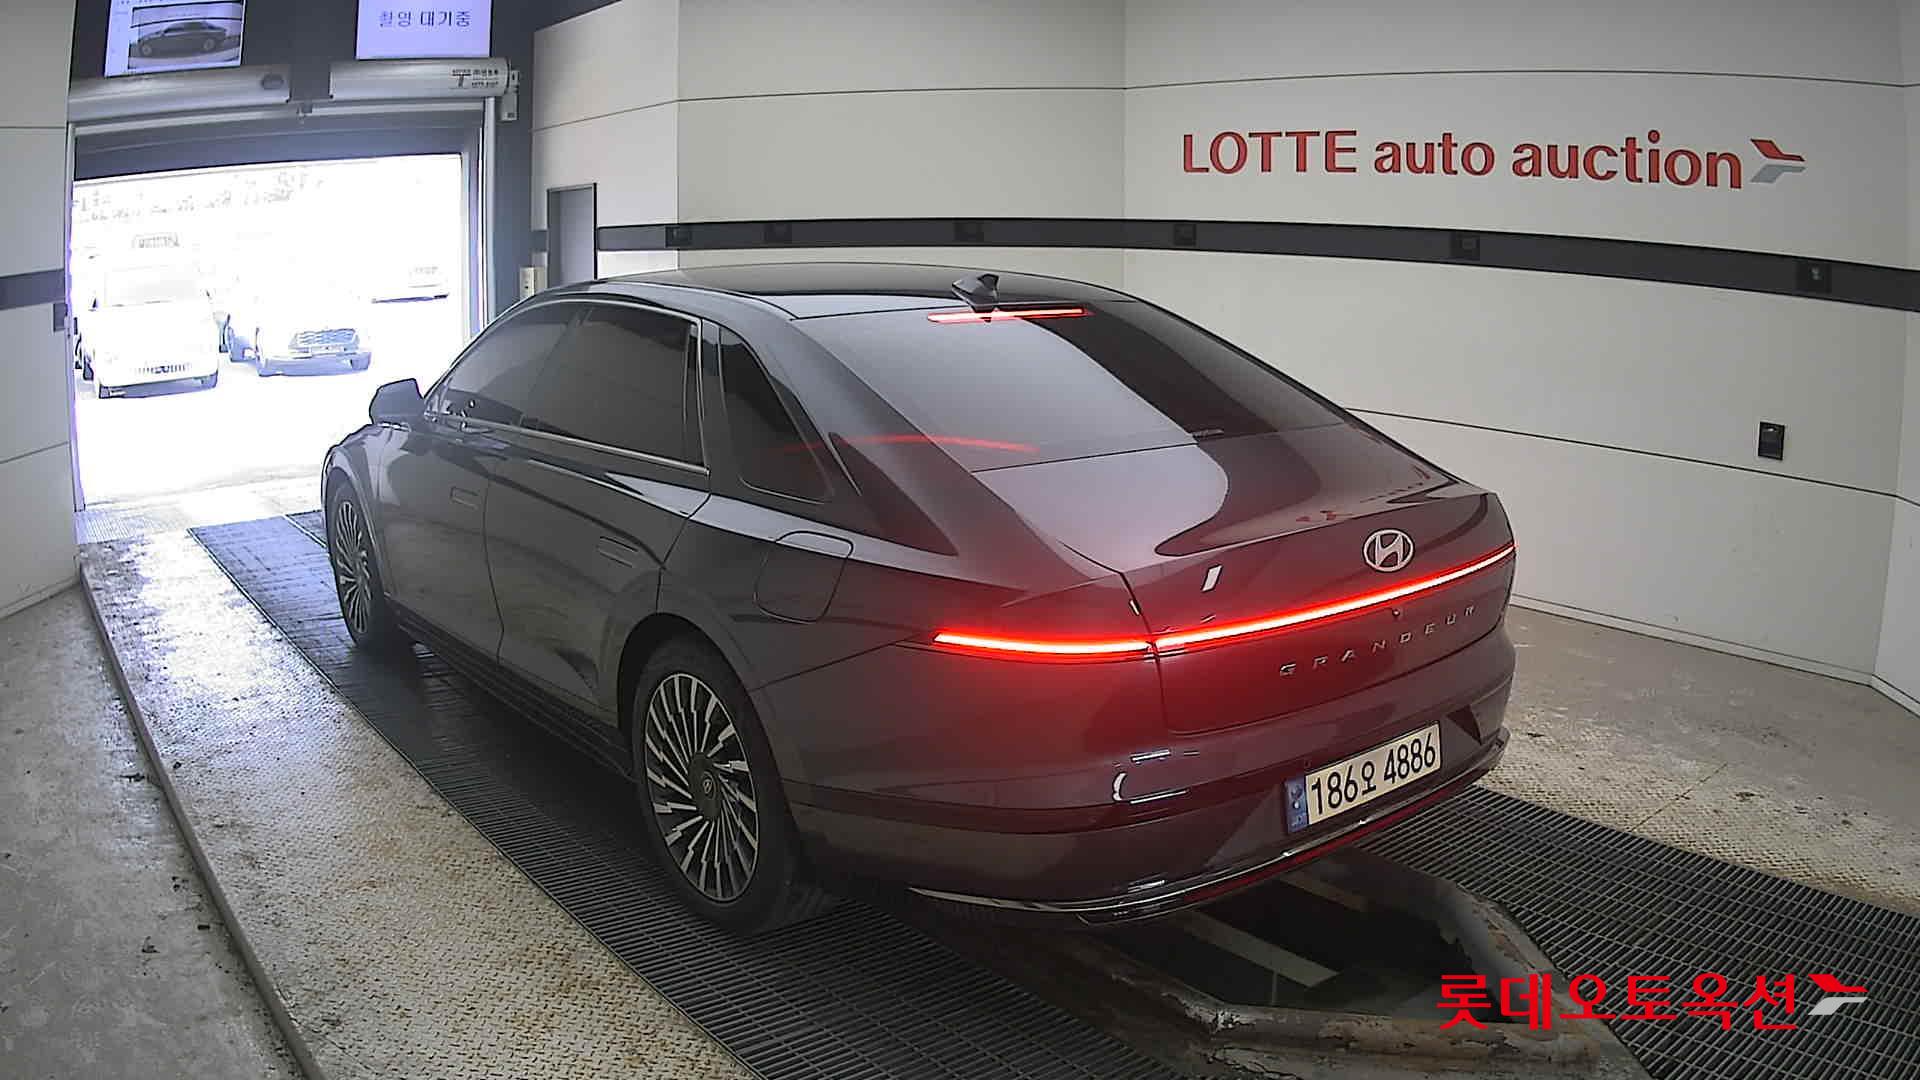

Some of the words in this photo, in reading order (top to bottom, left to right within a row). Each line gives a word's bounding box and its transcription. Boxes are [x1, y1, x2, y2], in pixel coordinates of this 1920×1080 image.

[420, 11, 472, 28] 대기중
[1183, 131, 1358, 174] LOTTE
[1374, 132, 1496, 178] auto
[1512, 130, 1742, 189] auction
[1311, 761, 1377, 815] 186오
[1383, 732, 1436, 785] 4886
